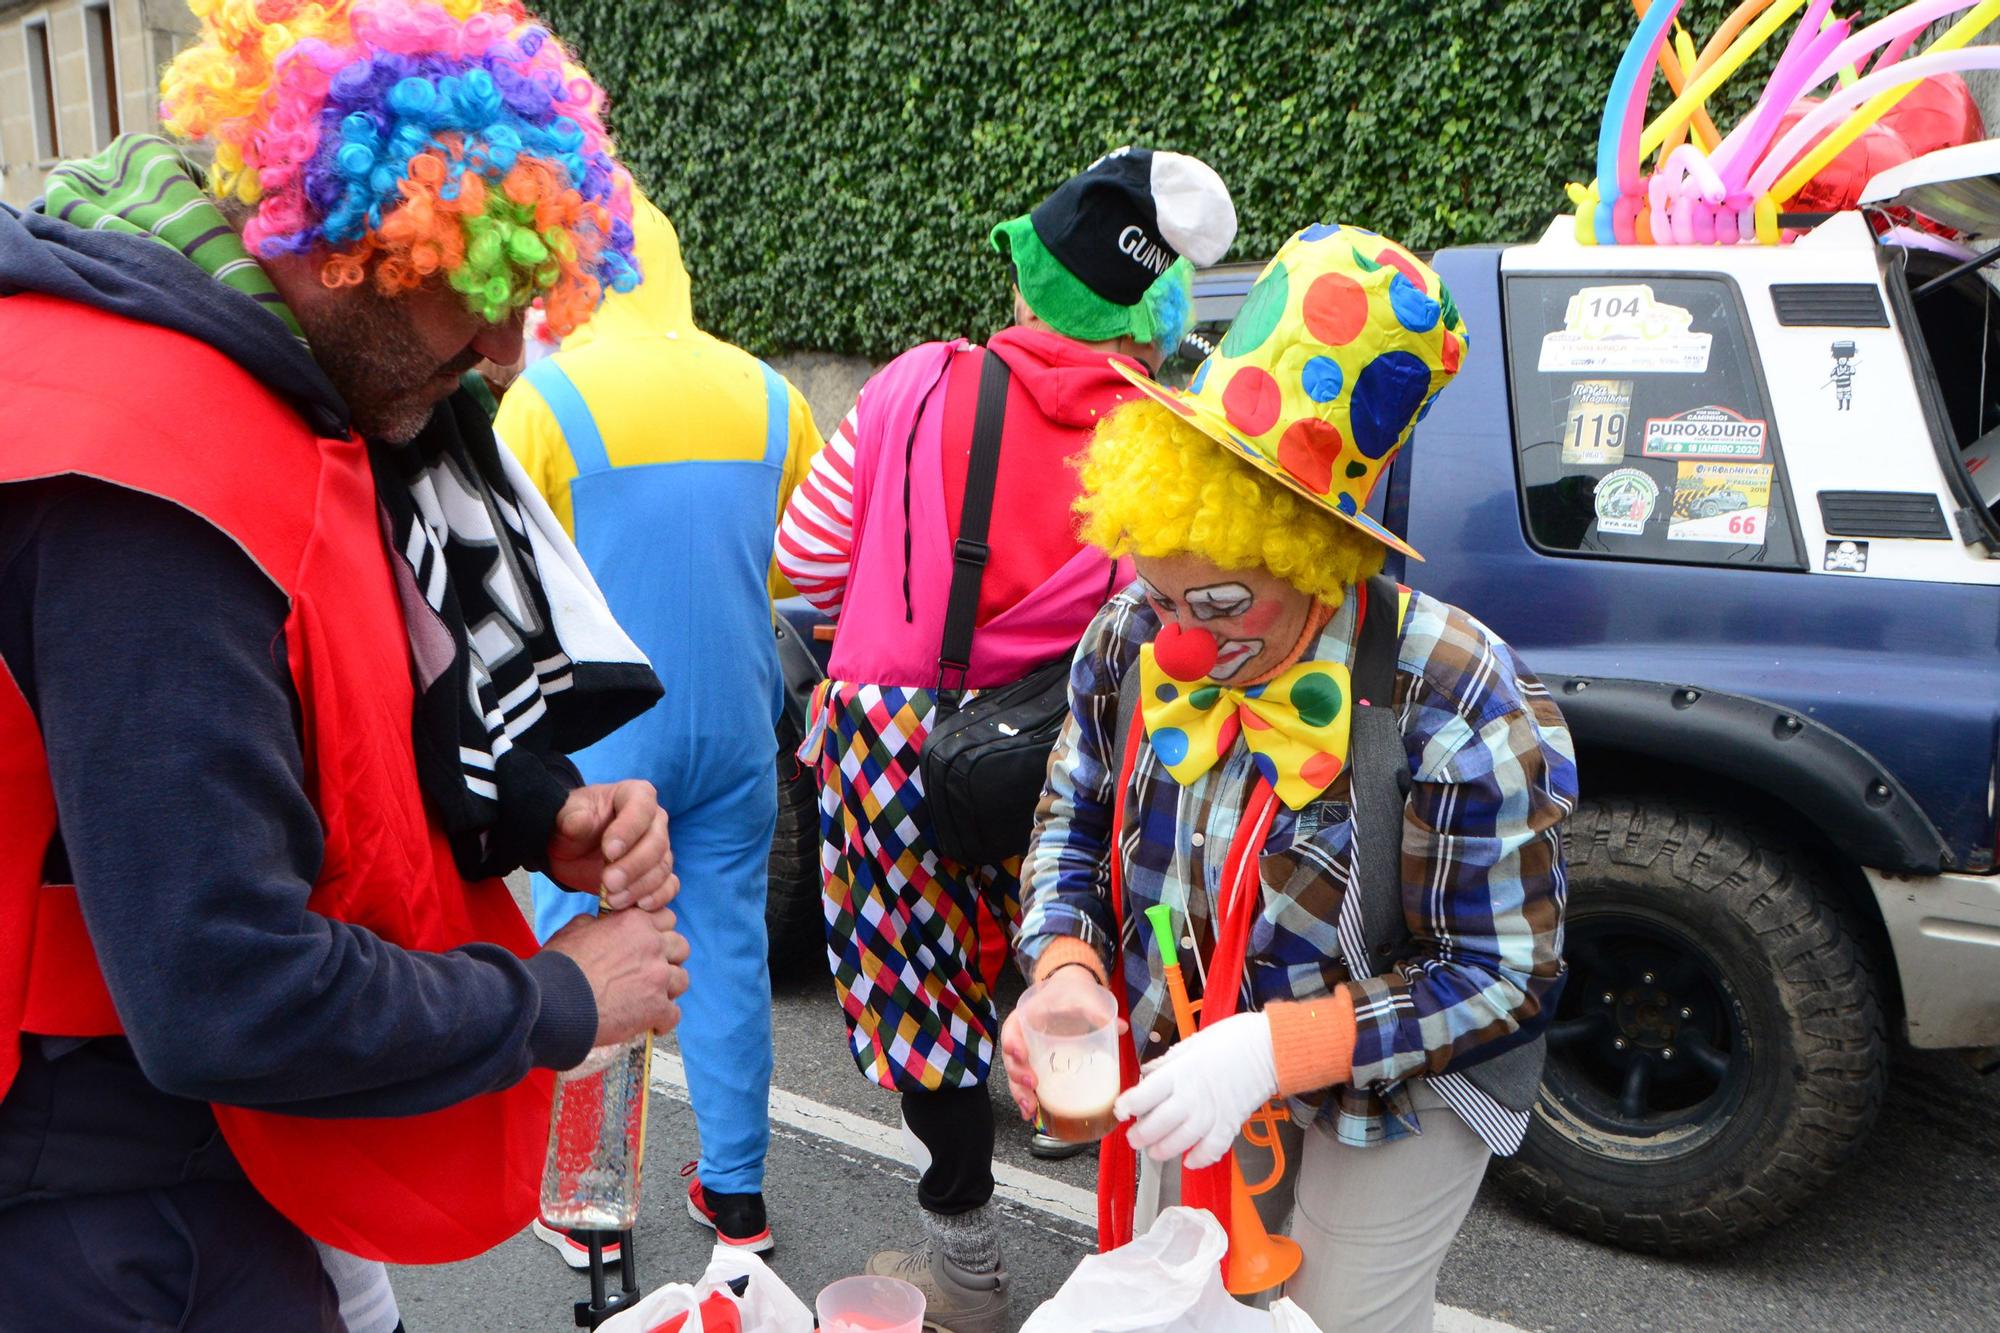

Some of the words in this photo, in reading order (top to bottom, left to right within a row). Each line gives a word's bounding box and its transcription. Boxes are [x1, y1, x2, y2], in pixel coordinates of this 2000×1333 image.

[1590, 297, 1640, 318] 104
[1573, 414, 1625, 447] 119
[1650, 424, 1761, 437] PURO&DURO
[1698, 444, 1733, 453] JANEIRO
[1735, 446, 1759, 454] 2020
[1728, 516, 1756, 535] 66
